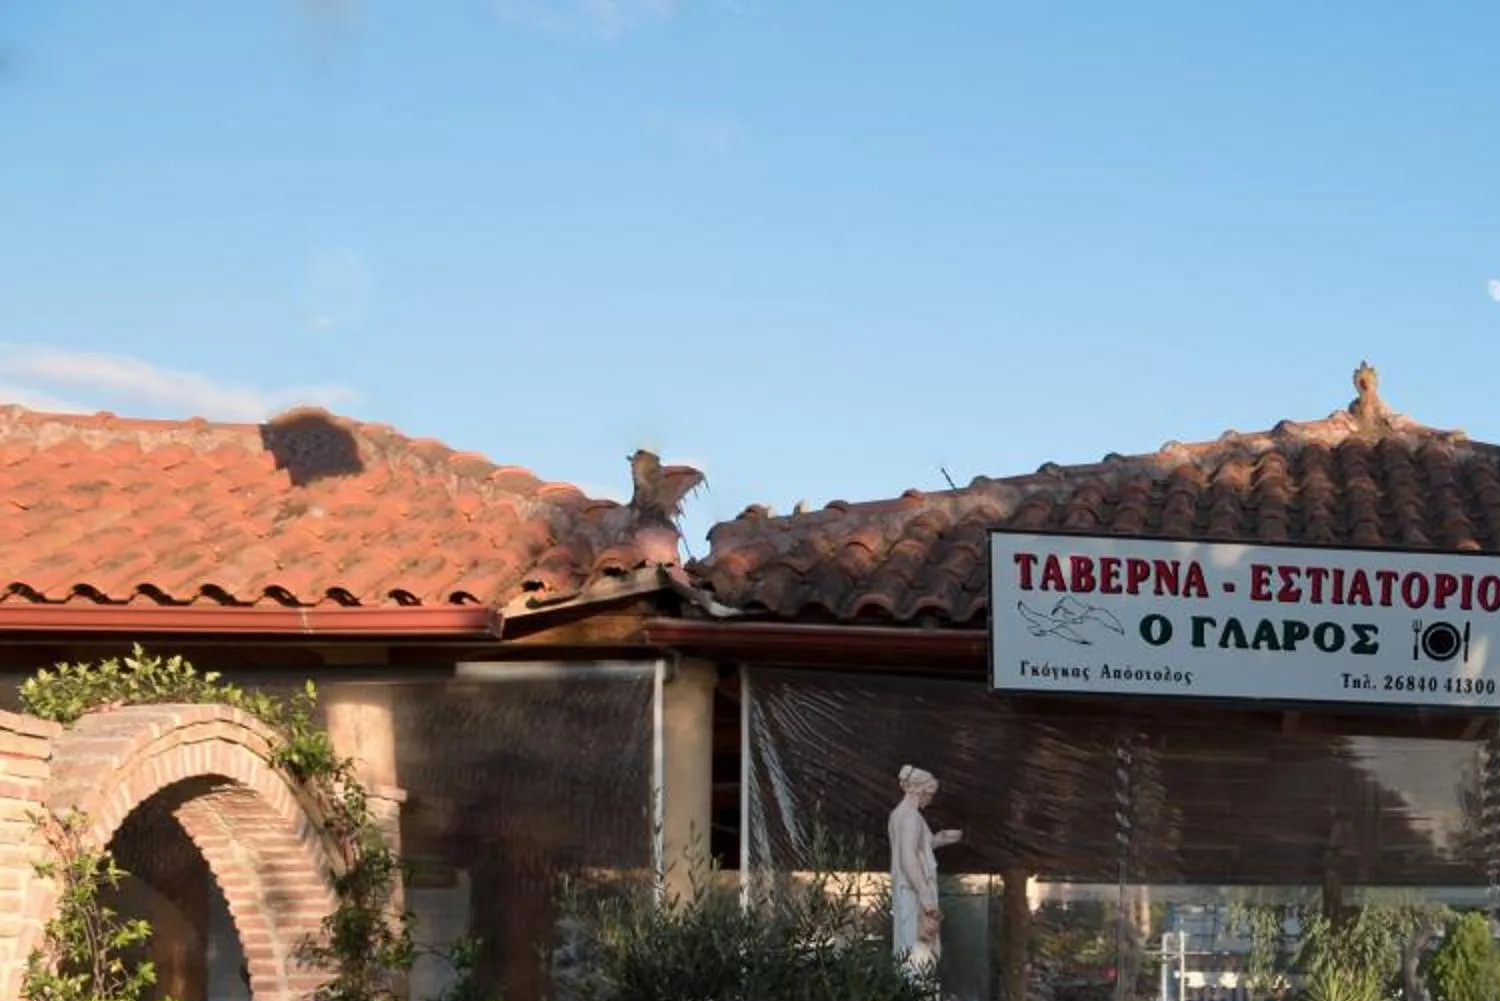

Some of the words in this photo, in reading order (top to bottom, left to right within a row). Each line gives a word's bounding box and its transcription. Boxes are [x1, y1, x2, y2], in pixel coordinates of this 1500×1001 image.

[1014, 553, 1209, 598] ΤΑΒΕΡΝΑ
[1139, 613, 1173, 646] Ο
[1191, 616, 1379, 655] ΓΛΑΡΟΣ
[1384, 674, 1438, 692] 26840
[1443, 677, 1496, 695] 41300
